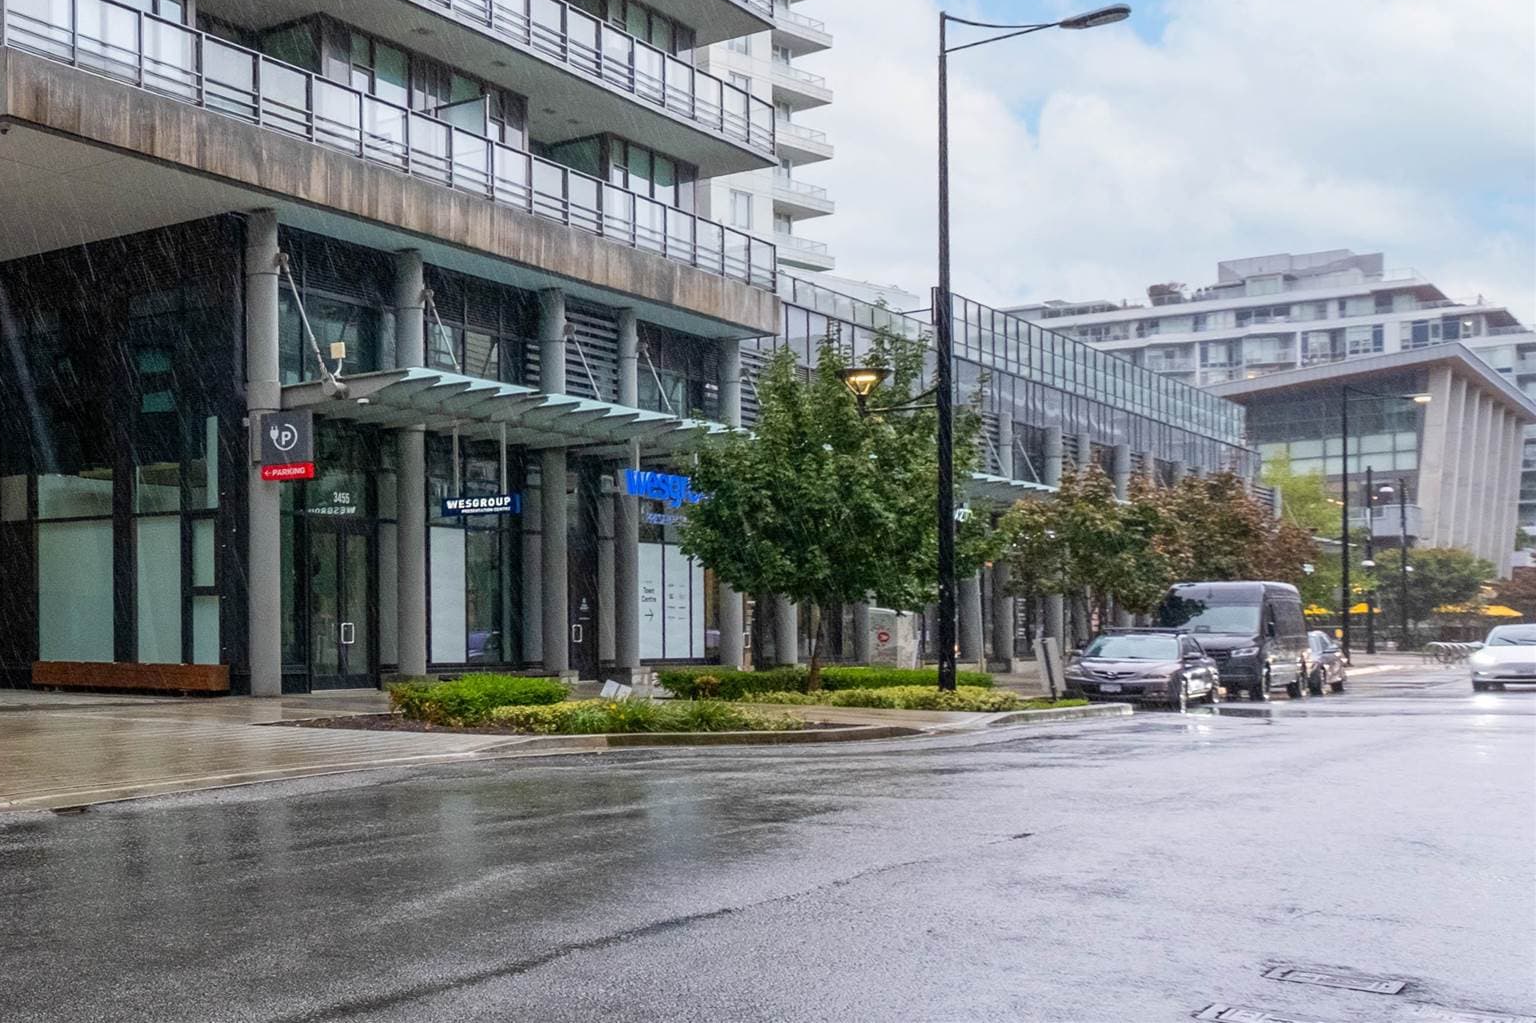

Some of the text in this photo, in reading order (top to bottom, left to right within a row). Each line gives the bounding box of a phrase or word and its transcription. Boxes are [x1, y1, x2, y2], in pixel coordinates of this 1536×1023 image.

[281, 431, 292, 446] P
[272, 467, 306, 477] PARKING
[333, 491, 350, 505] 3455
[446, 497, 511, 510] WESGROUP
